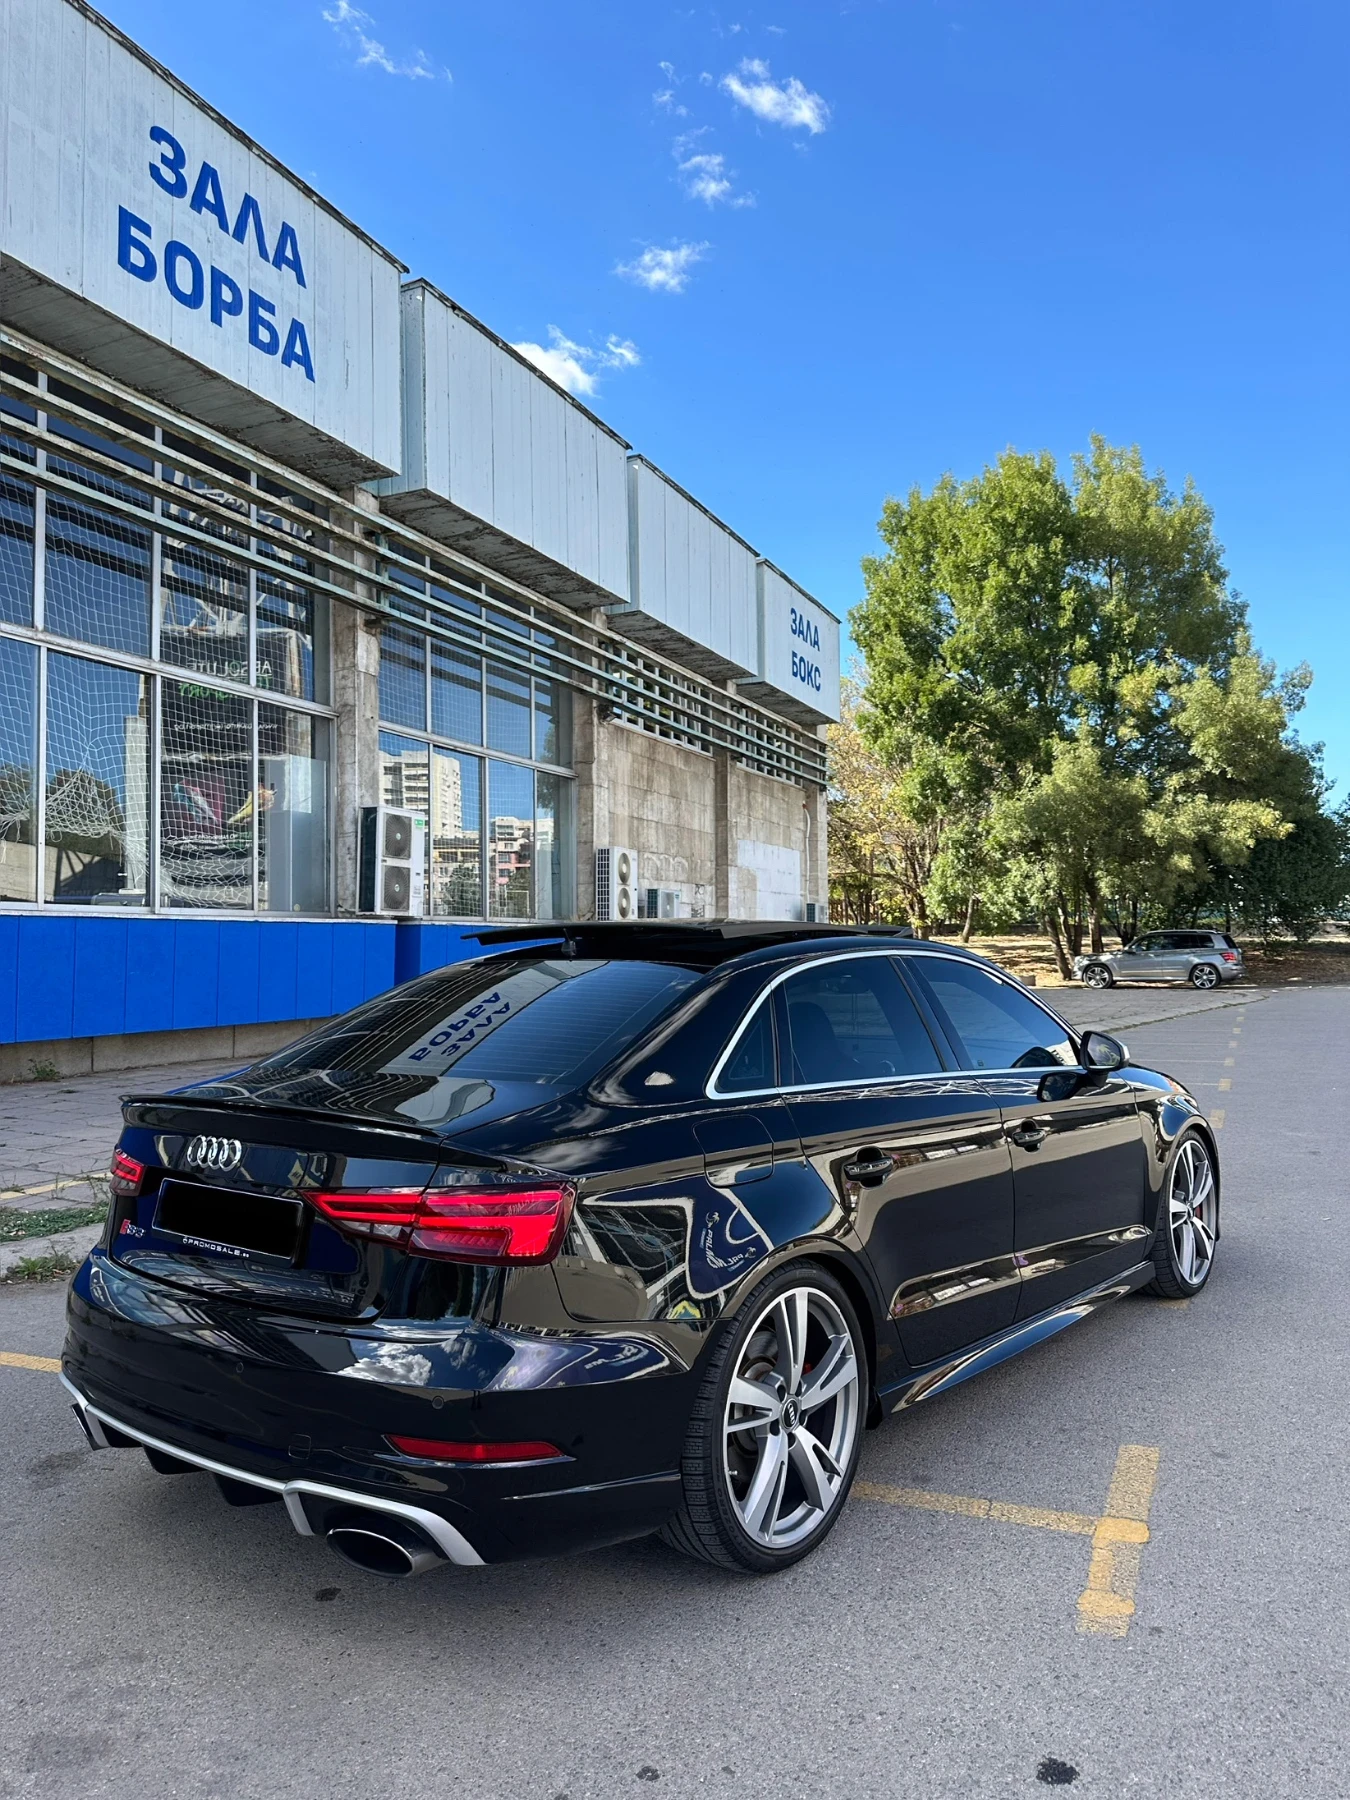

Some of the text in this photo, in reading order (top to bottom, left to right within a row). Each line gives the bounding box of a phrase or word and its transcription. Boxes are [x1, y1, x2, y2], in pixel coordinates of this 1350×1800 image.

[149, 125, 307, 289] ЗАЛА
[117, 204, 316, 384] БОРБА
[790, 607, 820, 652] ЗАЛА
[791, 650, 821, 692] БОКС
